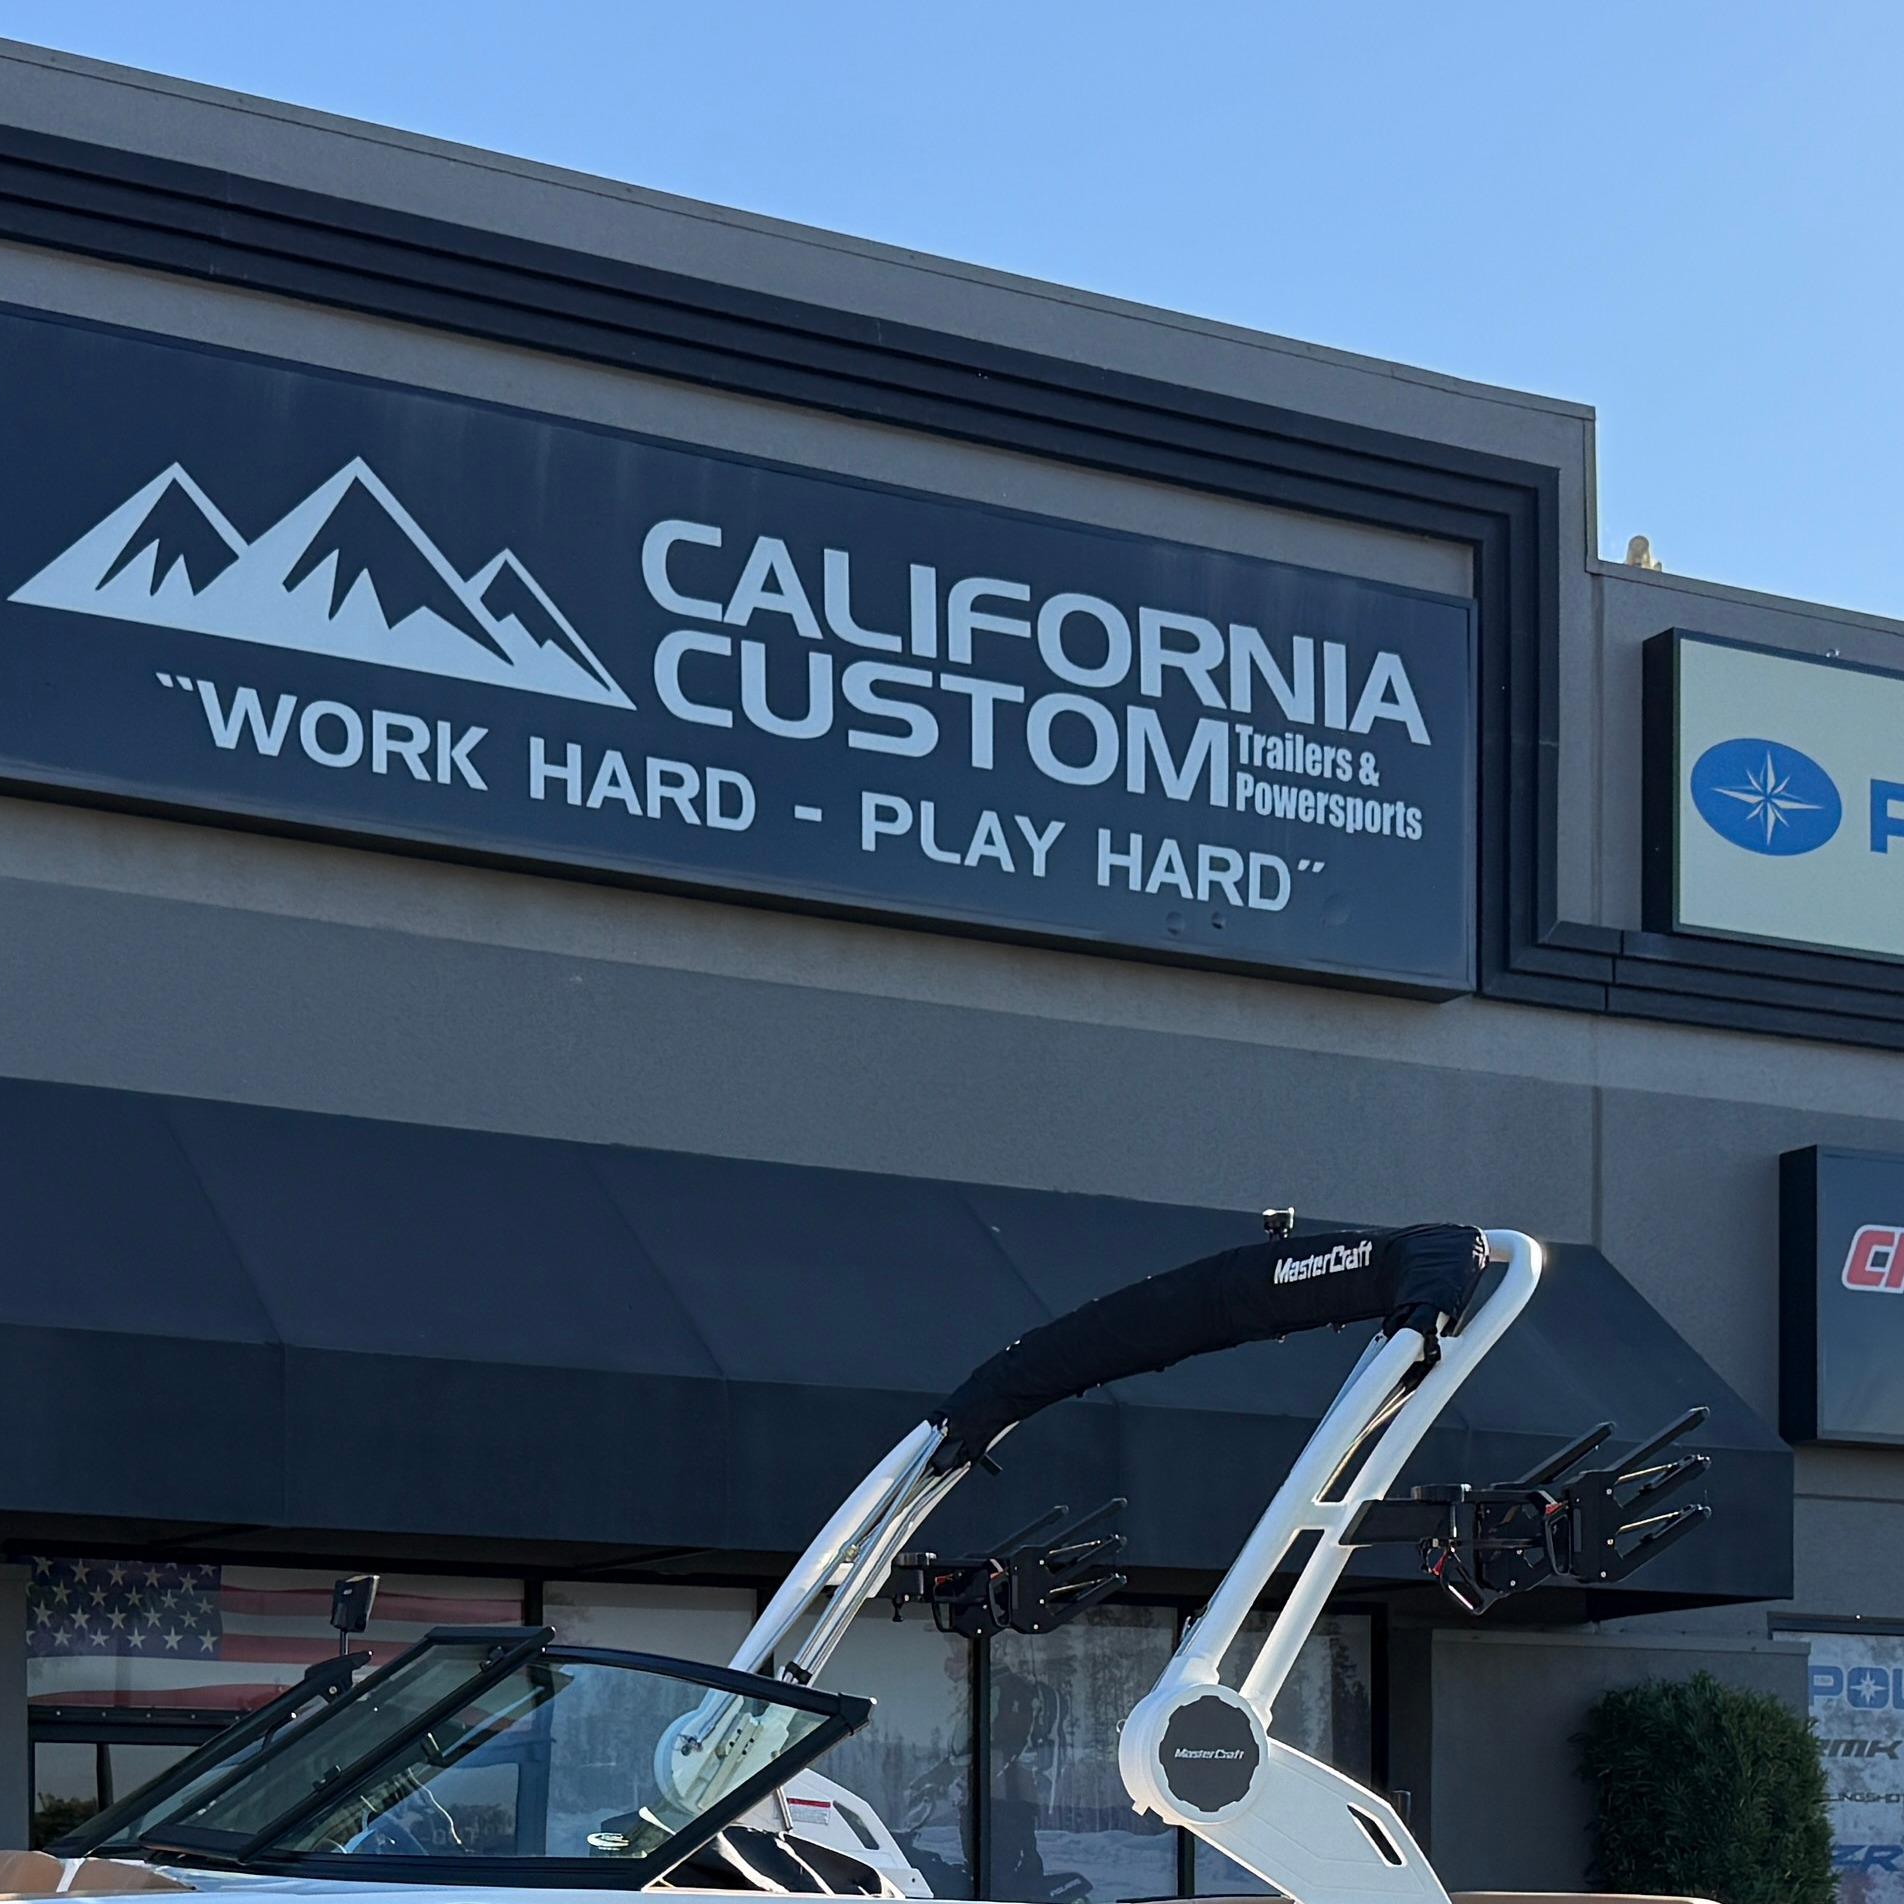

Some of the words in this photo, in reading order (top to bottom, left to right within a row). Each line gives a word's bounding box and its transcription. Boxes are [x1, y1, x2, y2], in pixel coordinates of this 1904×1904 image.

[642, 519, 1431, 745] CALIFORNIA
[654, 630, 1228, 808] CUSTOM
[1235, 724, 1353, 781] Trailers
[1359, 752, 1381, 787] &
[530, 736, 757, 831] HARD
[861, 791, 1065, 876] PLAY
[1236, 770, 1423, 841] Powersports
[1274, 1240, 1372, 1284] MasterCraft
[1175, 1748, 1245, 1760] MasterCraft
[1831, 1844, 1904, 1872] ZR
